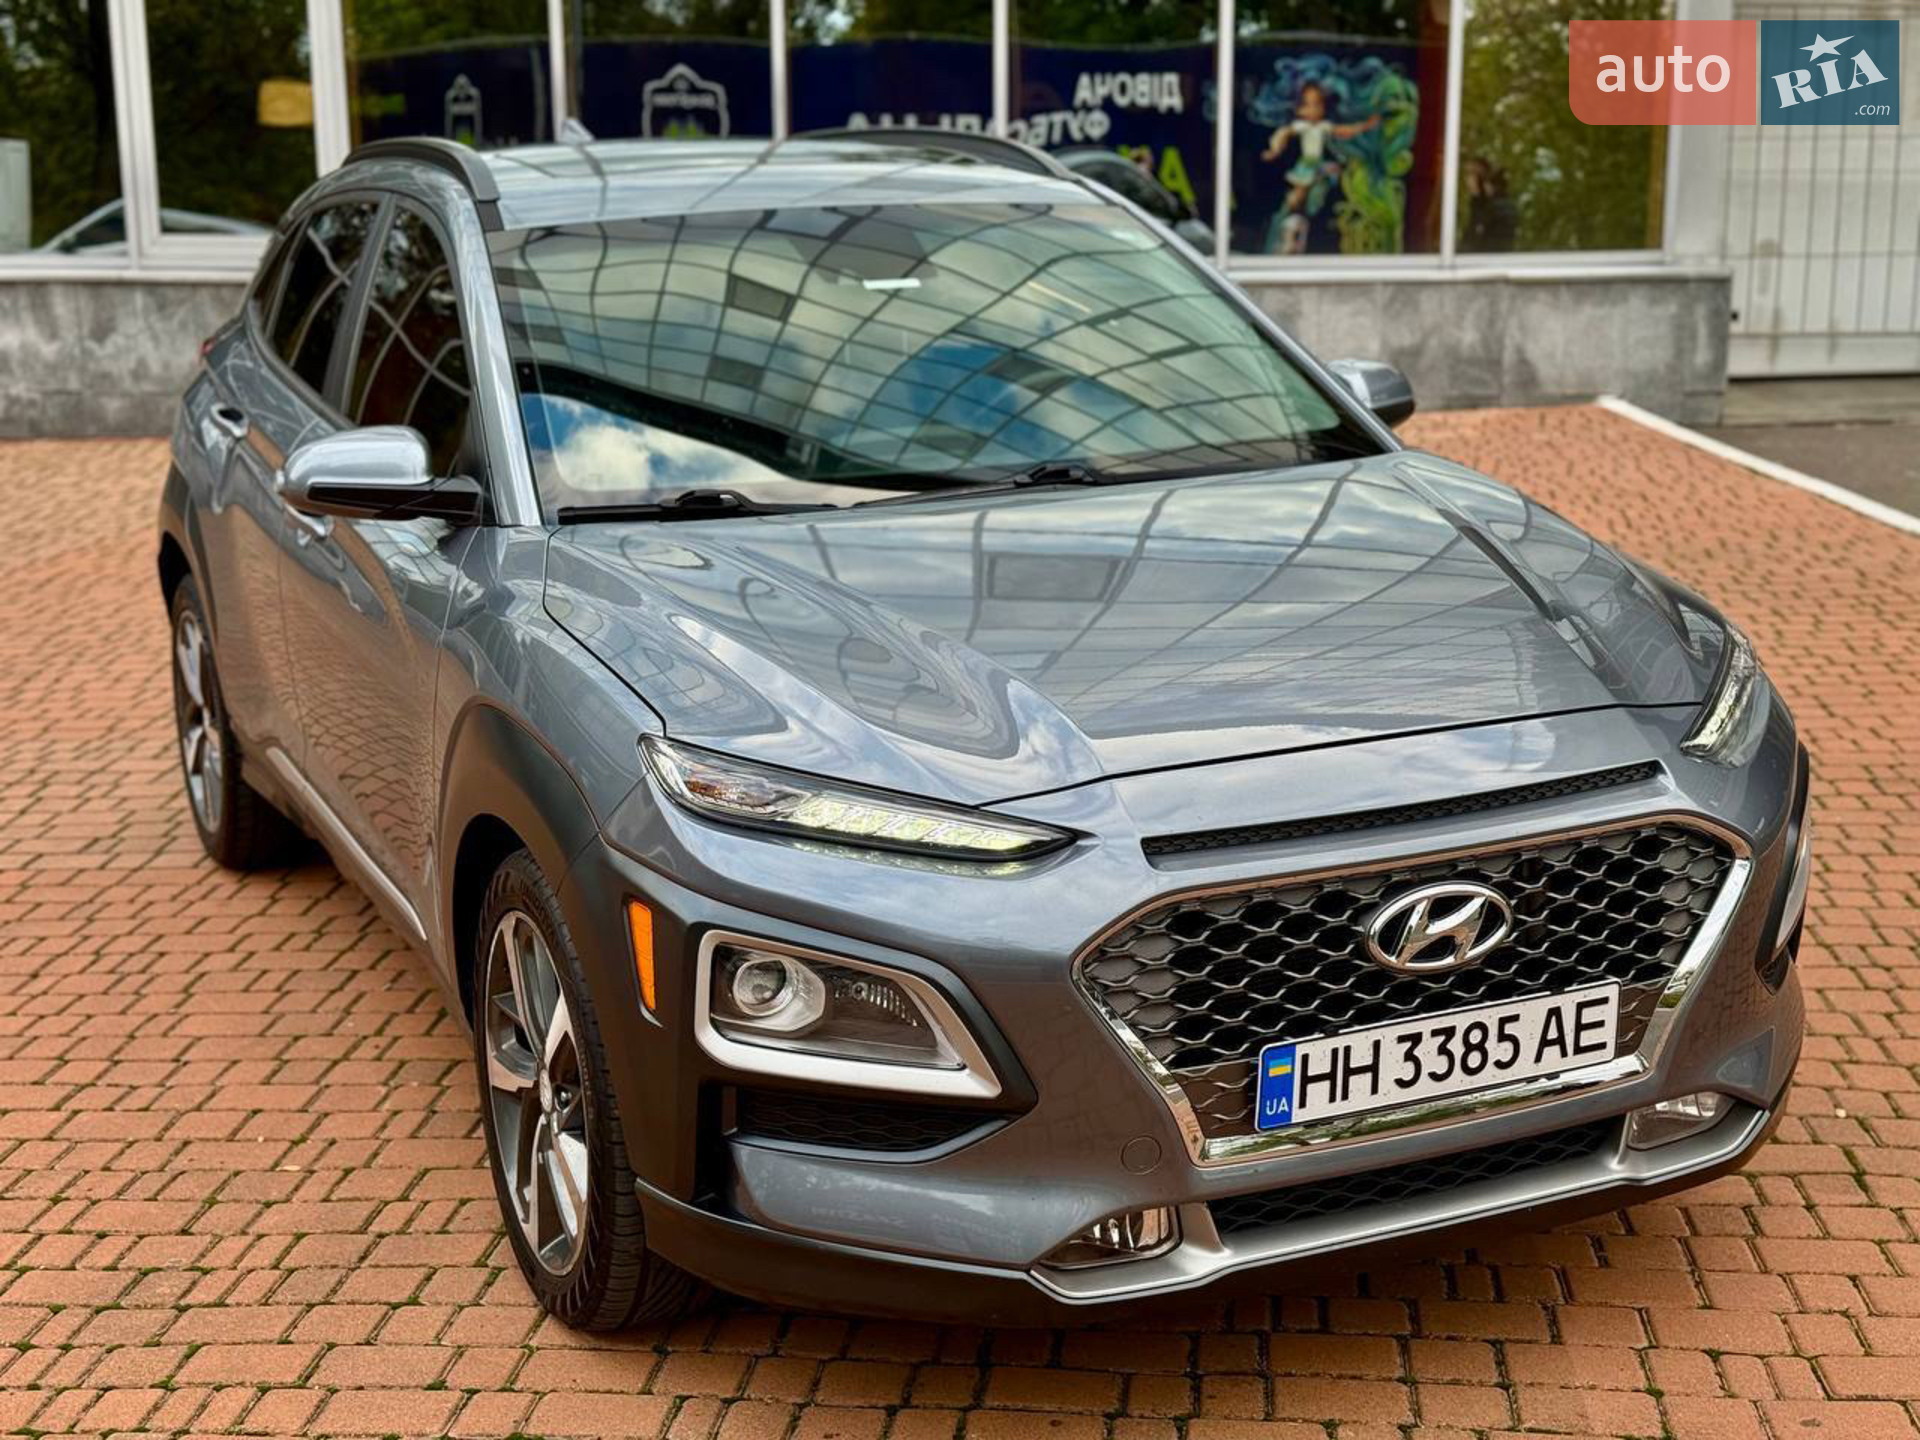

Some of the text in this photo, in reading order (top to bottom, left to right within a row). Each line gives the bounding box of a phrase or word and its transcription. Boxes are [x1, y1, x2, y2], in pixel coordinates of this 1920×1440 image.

[1297, 995, 1611, 1110] HH 3385 AE
[1265, 1097, 1290, 1116] UA
